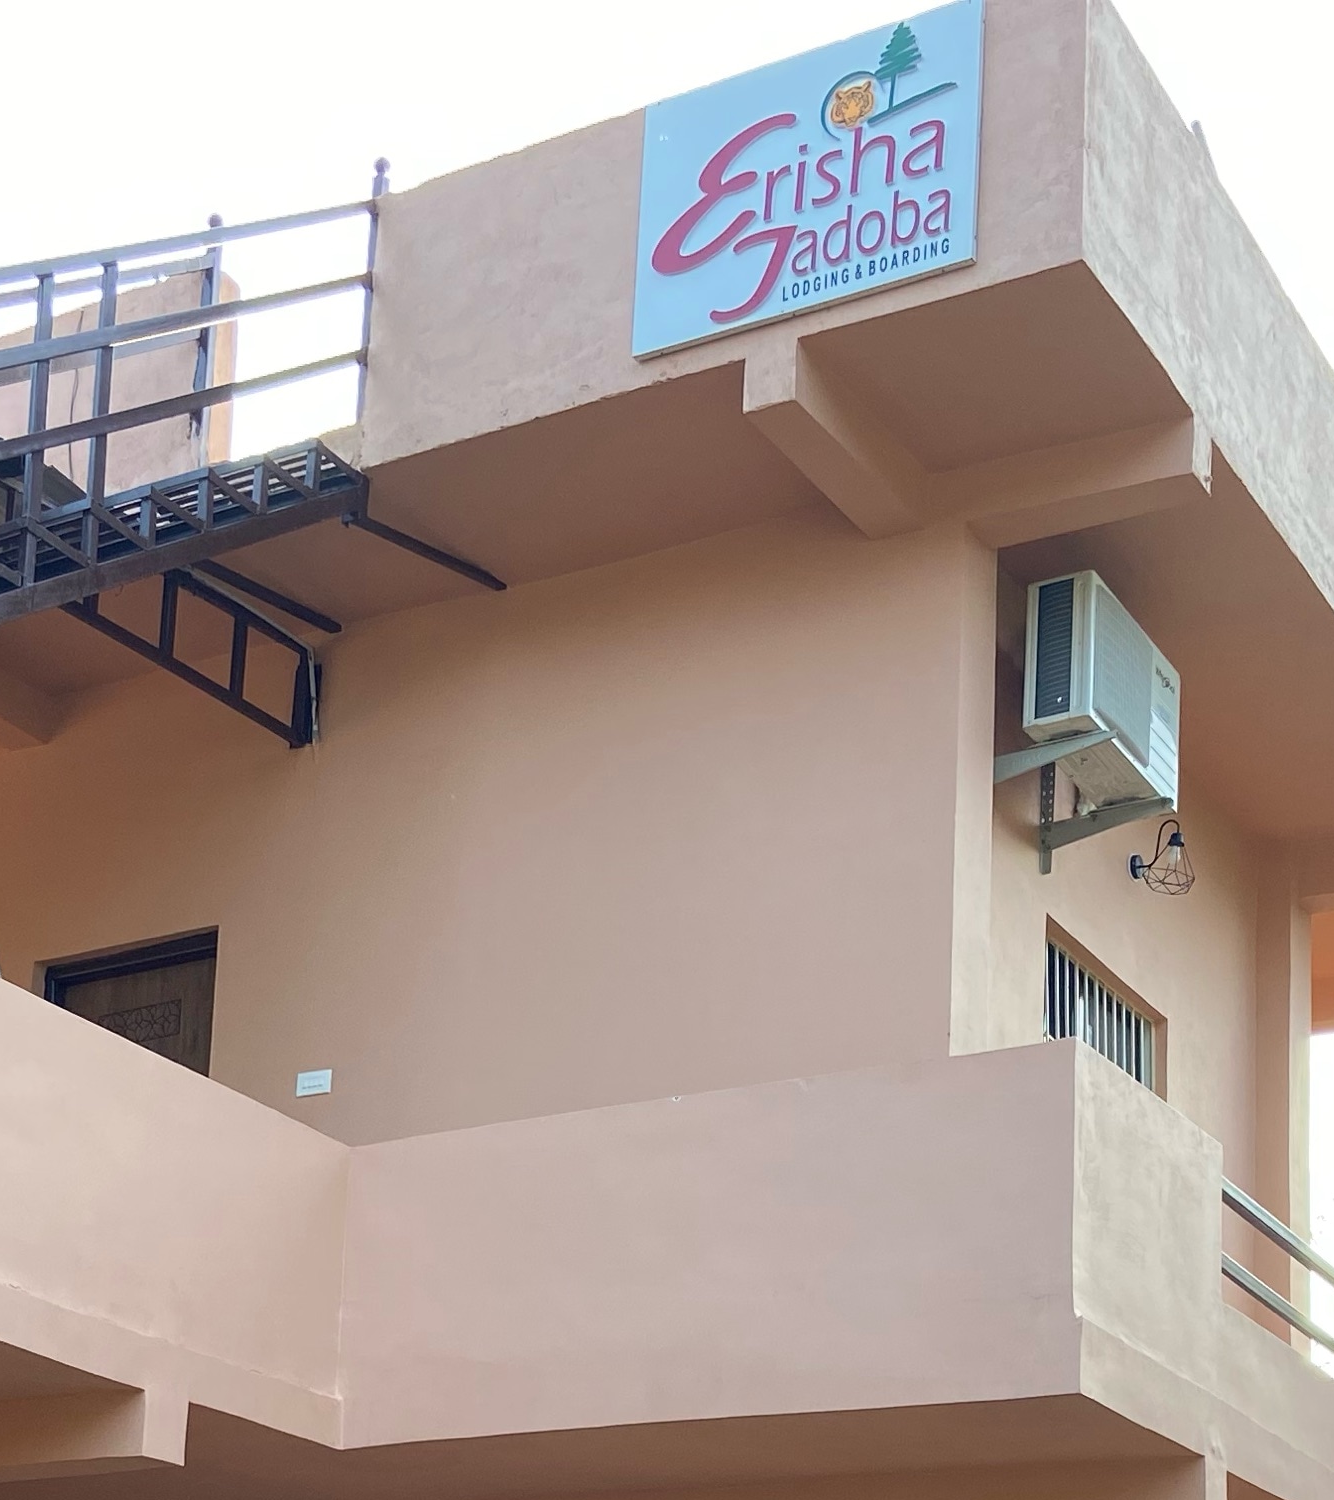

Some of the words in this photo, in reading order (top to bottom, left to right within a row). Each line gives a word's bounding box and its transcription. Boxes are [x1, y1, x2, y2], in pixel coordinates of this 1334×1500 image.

[652, 113, 946, 276] Erisha
[782, 268, 850, 303] LODGING
[855, 264, 863, 280] &
[868, 238, 950, 276] BOARDING
